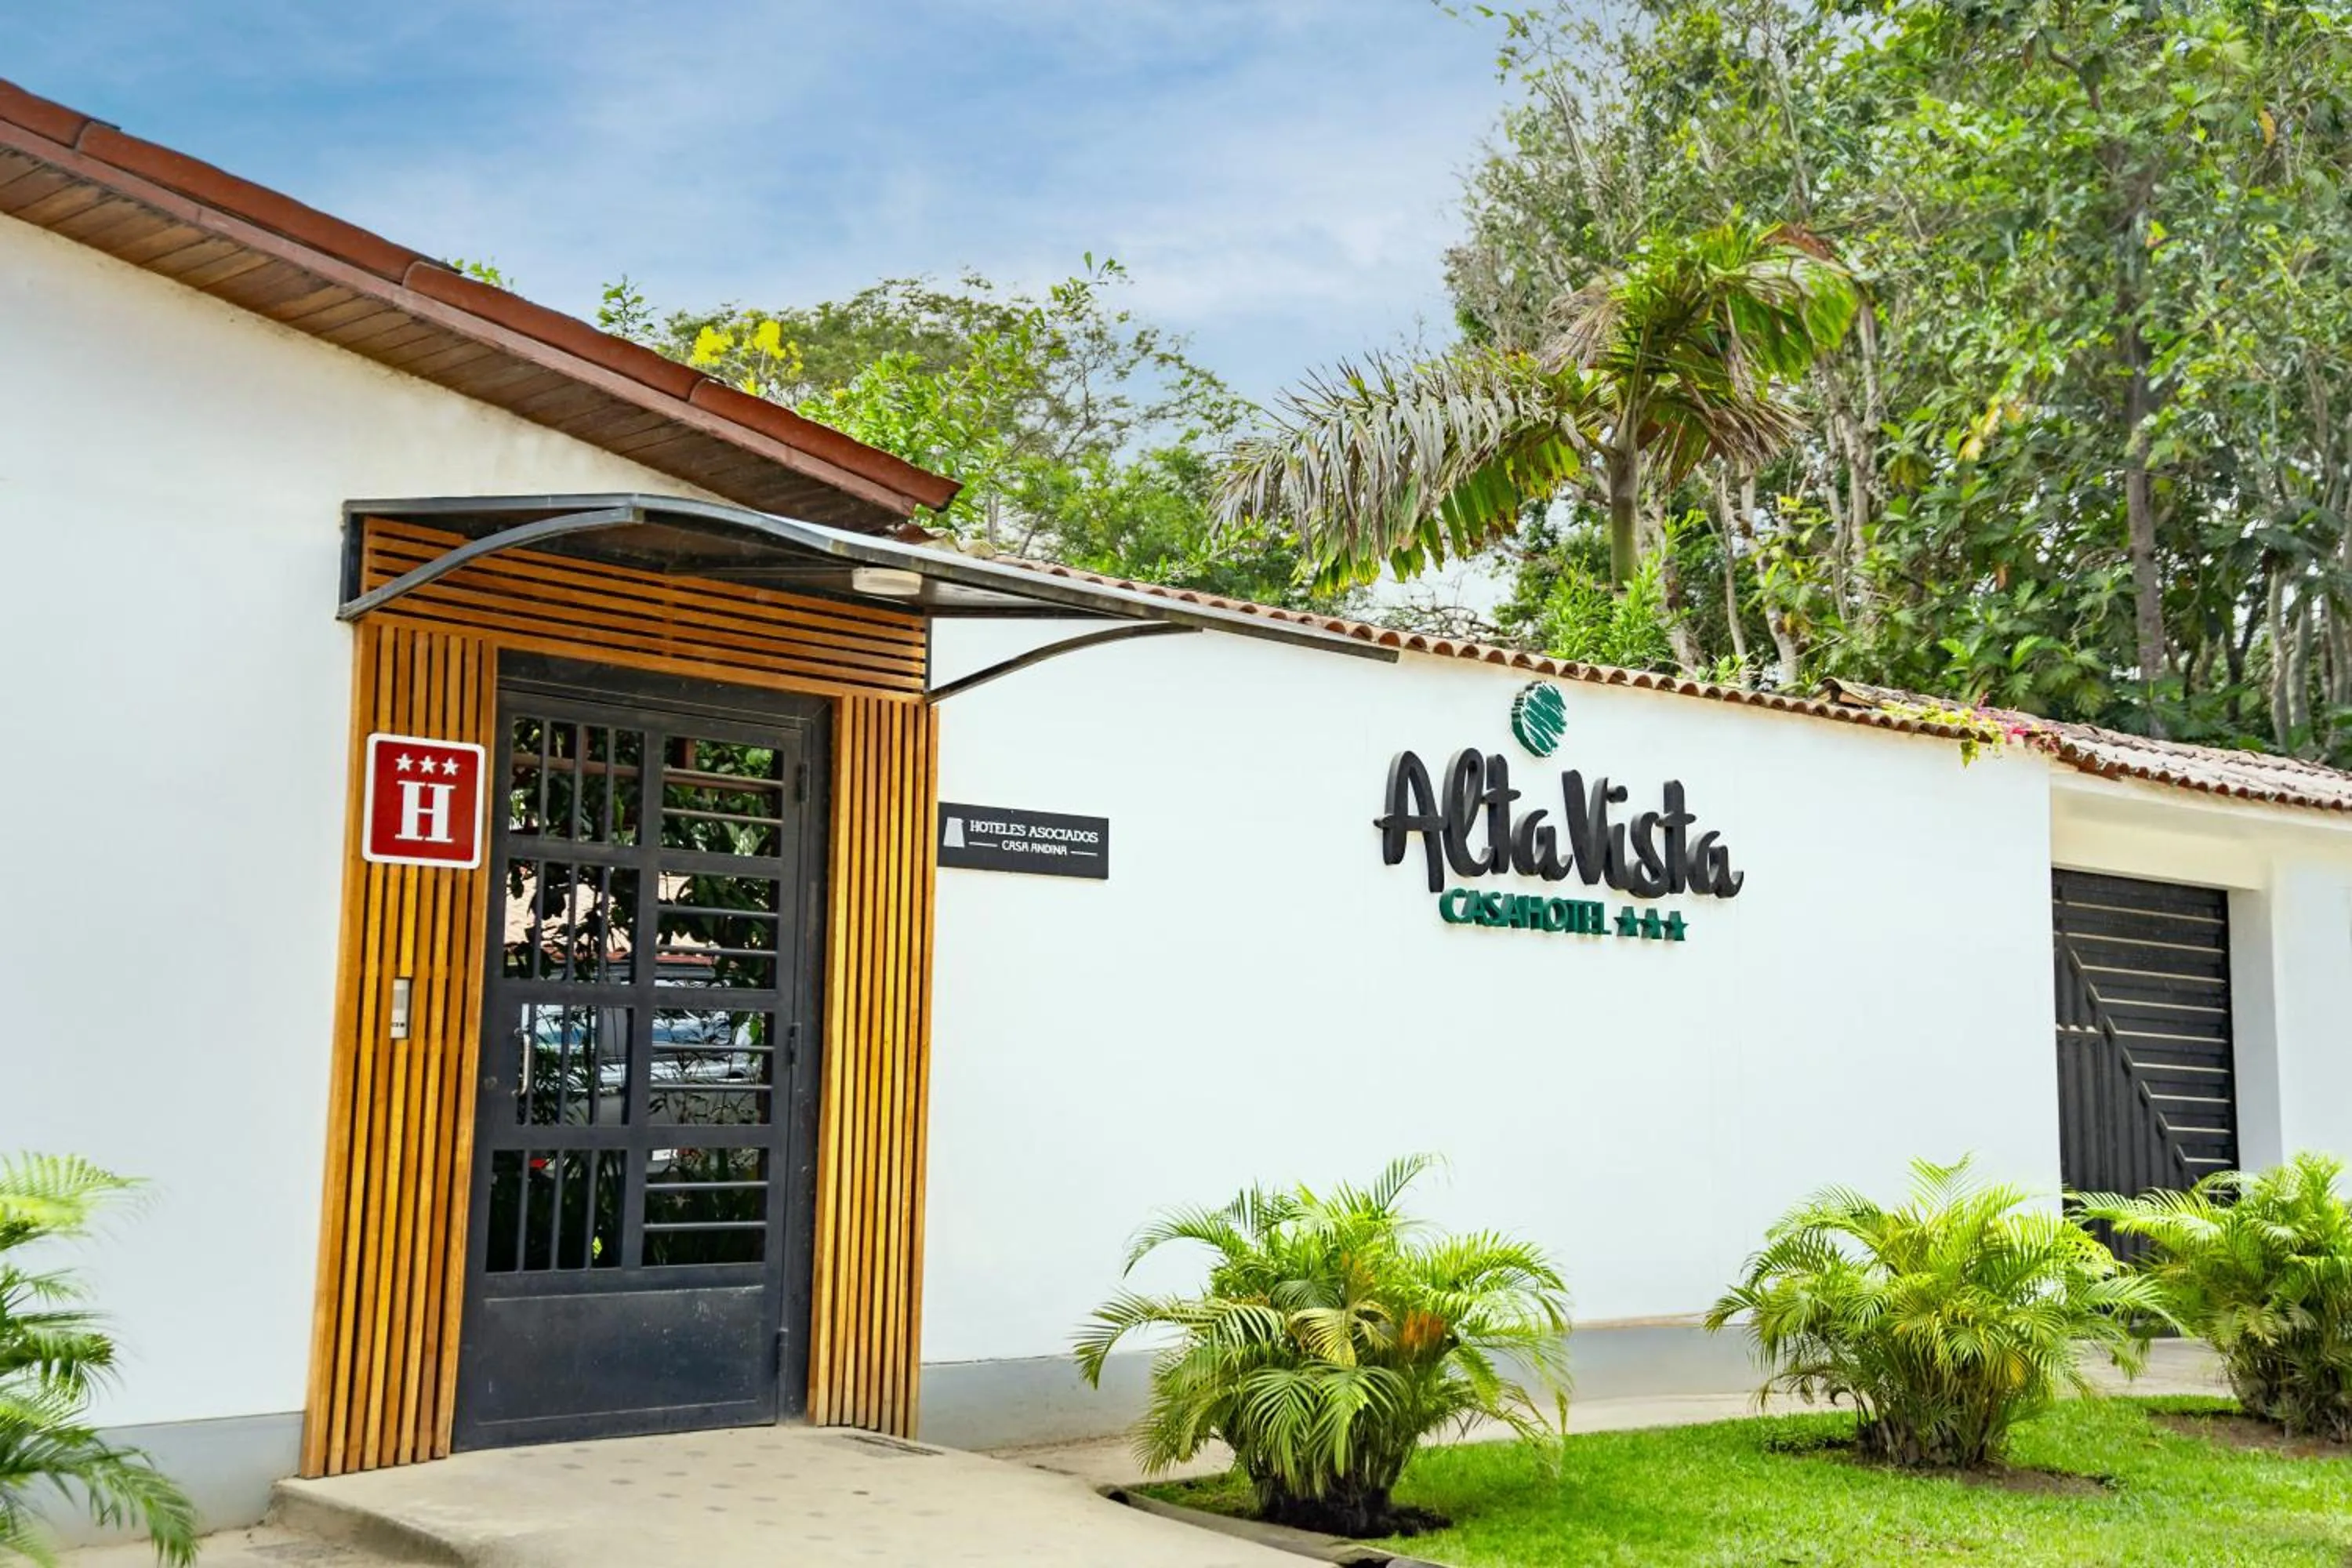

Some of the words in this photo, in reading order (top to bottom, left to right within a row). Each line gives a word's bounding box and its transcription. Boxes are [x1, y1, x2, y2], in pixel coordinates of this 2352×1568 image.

[394, 780, 456, 843] H
[969, 819, 1026, 837] HOTELES
[1029, 826, 1098, 843] ASOCIADOS
[1002, 840, 1029, 852] CASA
[1030, 844, 1067, 855] ANDINA
[1439, 888, 1611, 935] CASAHOTEL
